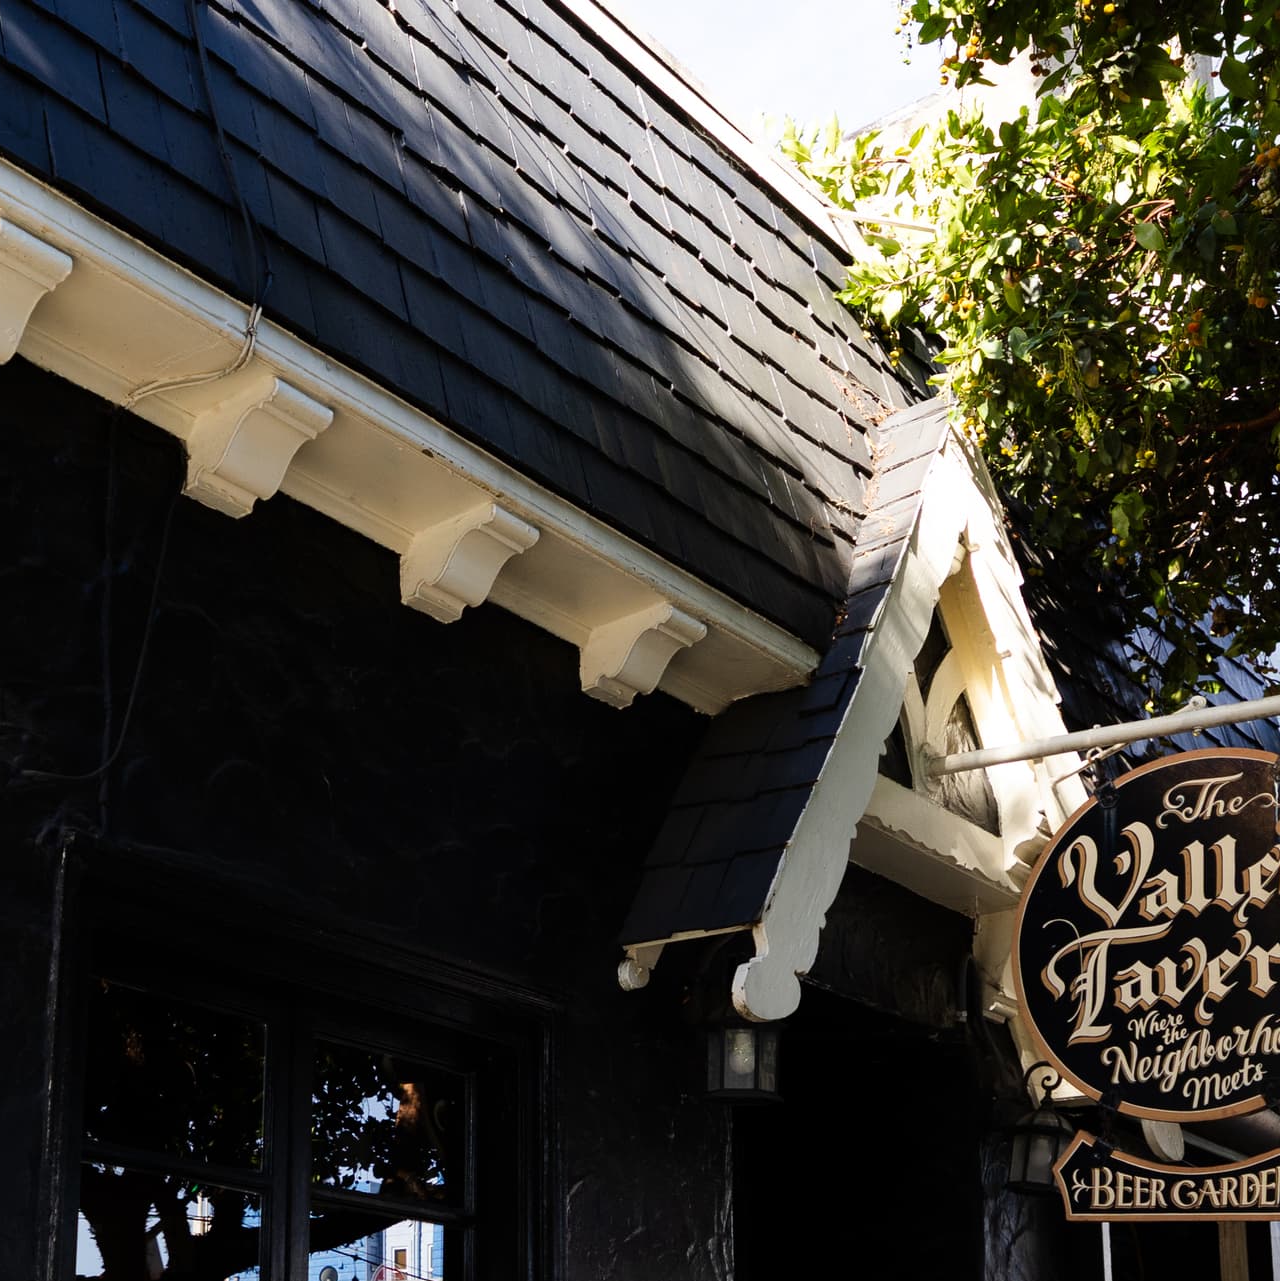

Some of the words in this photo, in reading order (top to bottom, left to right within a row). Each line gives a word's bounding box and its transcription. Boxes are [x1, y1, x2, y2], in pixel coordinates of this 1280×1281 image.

[1156, 772, 1278, 829] The
[1127, 1010, 1185, 1041] Where
[1162, 1024, 1189, 1044] the
[1182, 1065, 1268, 1110] Meets
[1090, 1166, 1166, 1209] BEER
